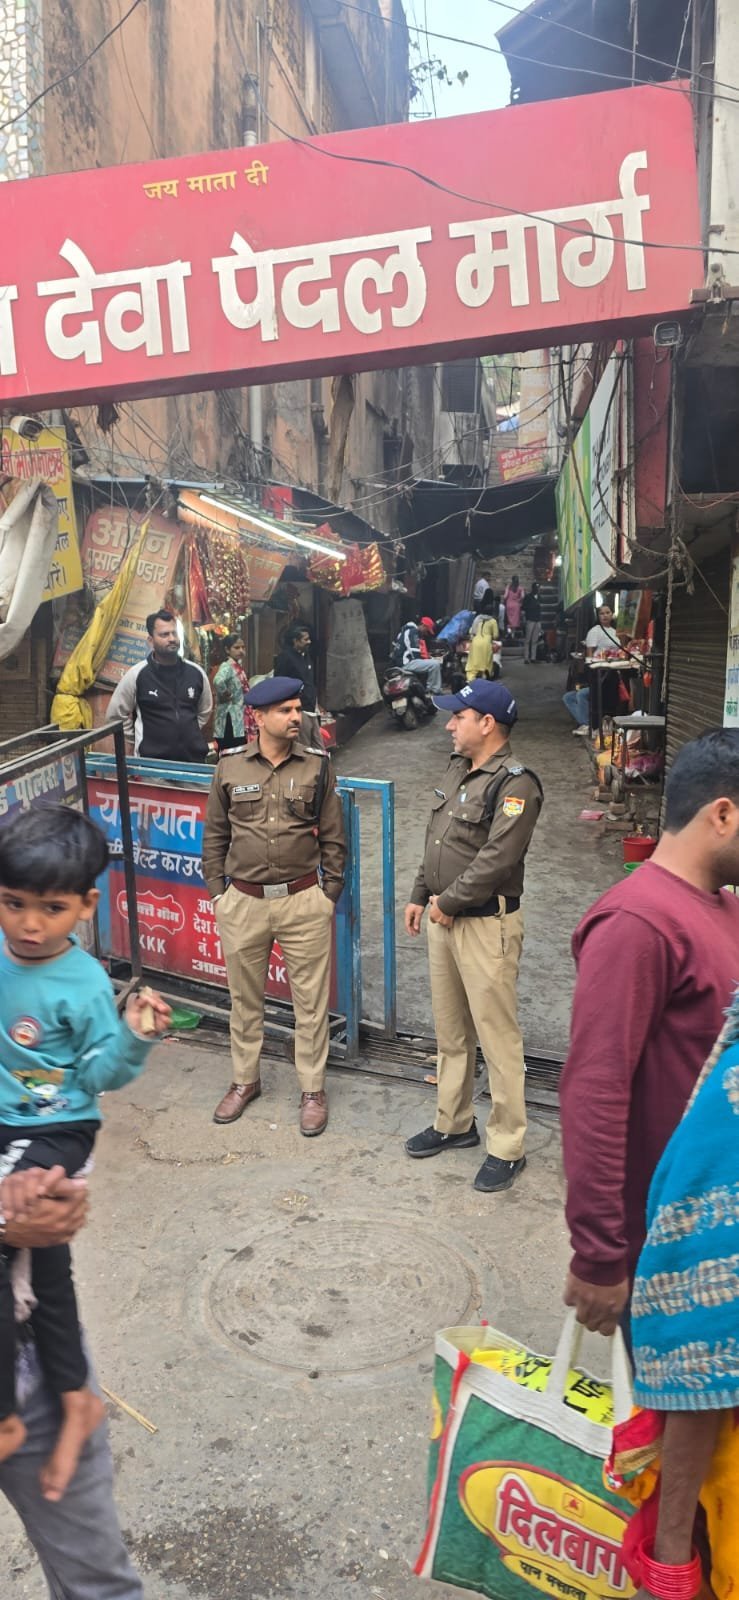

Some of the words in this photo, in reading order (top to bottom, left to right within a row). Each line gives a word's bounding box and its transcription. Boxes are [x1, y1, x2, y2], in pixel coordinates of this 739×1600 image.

[143, 179, 179, 199] जय
[186, 171, 237, 194] माता
[244, 160, 269, 186] दी
[37, 238, 192, 365] देवा
[211, 225, 432, 342] पेदल
[449, 151, 651, 308] मार्ग
[95, 791, 202, 841] यतायात
[161, 851, 183, 875] का
[182, 855, 205, 880] उप
[193, 913, 211, 935] देश
[197, 898, 215, 916] अप
[192, 958, 228, 978] आट
[497, 1475, 624, 1589] दिलबाग
[519, 1560, 543, 1581] पान
[545, 1572, 588, 1600] मसाला
